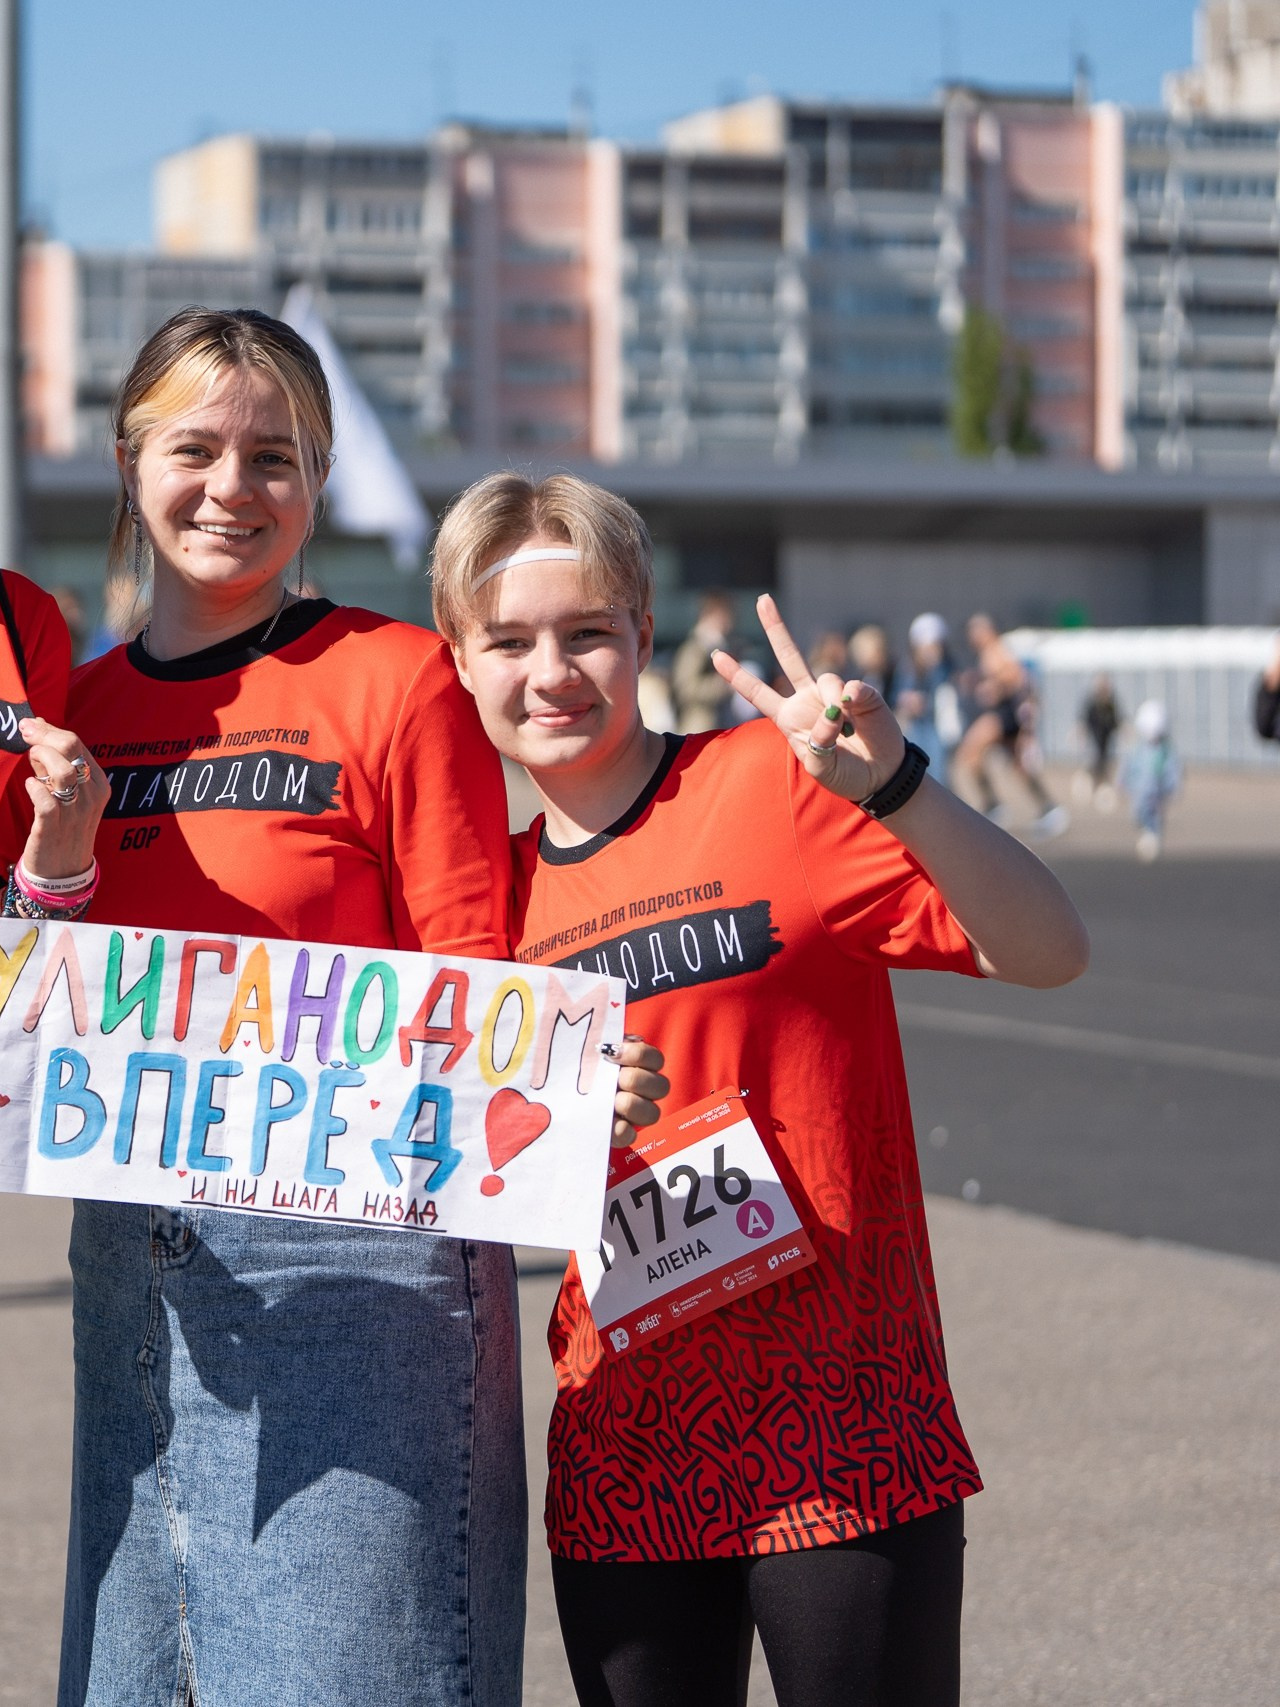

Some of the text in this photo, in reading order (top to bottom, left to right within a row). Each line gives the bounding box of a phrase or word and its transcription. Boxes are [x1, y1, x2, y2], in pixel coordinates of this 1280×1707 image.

[193, 734, 223, 751] ДЛЯ
[223, 728, 310, 748] ПОДРОСТКОВ
[107, 757, 309, 811] ГАНОДОМ
[120, 825, 161, 850] БОР
[600, 905, 625, 932] ДЛЯ
[628, 880, 724, 920] ПОДРОСТКОВ
[678, 1102, 730, 1131] НИЖНИЙ НОВГОРОД
[191, 1175, 439, 1226] И НИ ШАГА НАЗАД
[646, 1238, 713, 1284] АЛЕНА
[778, 1246, 801, 1263] ПСБ
[747, 1274, 758, 1283] 2024
[679, 1287, 712, 1306] НИЖЕГОРОДСКАЯ
[681, 1300, 699, 1312] ОБЛАСТЬ
